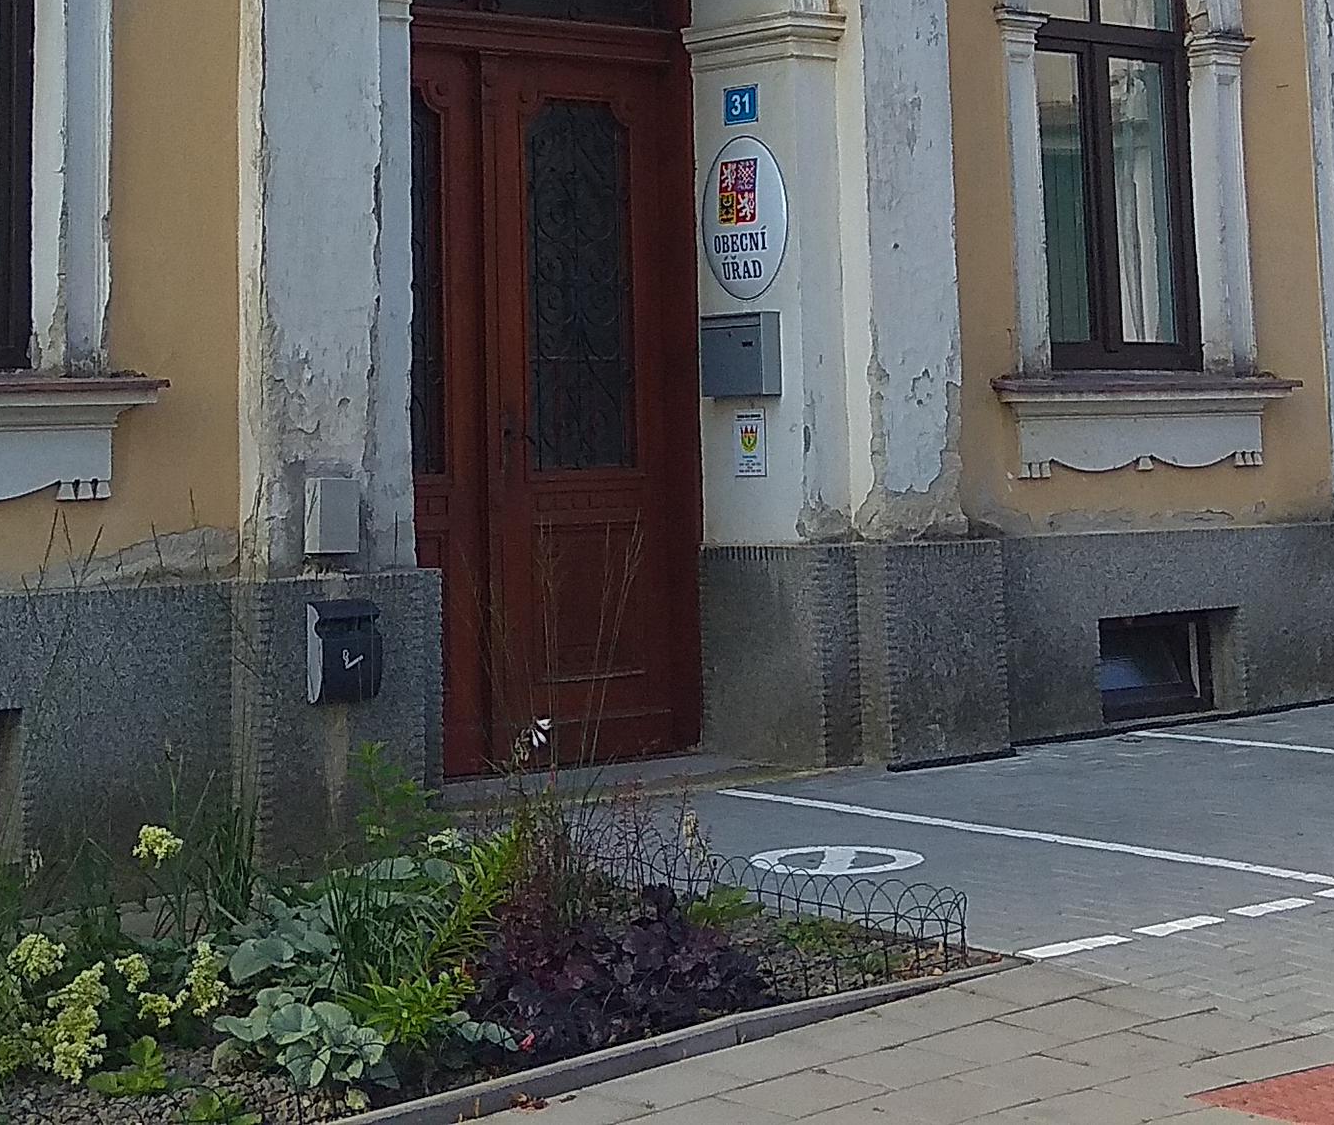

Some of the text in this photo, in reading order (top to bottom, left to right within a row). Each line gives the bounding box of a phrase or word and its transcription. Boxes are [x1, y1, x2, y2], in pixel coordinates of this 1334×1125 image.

[731, 92, 750, 115] 31
[714, 225, 767, 254] OBECNÍ
[721, 255, 762, 280] ÚŘAD
